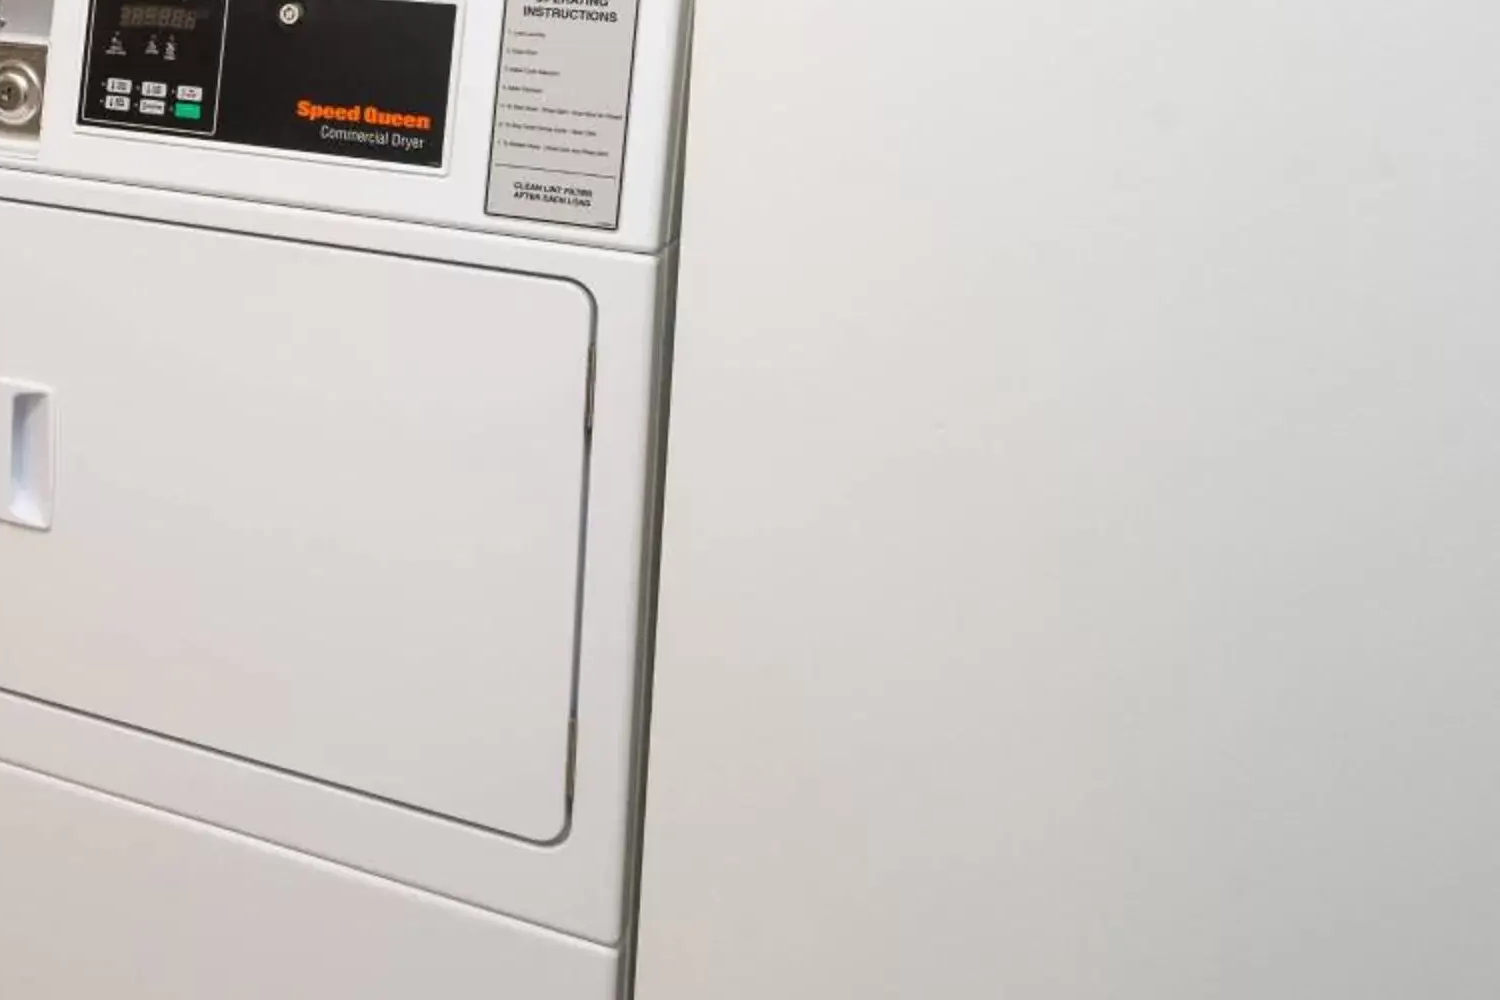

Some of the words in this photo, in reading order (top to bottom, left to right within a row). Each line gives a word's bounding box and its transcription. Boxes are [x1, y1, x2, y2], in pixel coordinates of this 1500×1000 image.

[523, 5, 618, 23] INSTRUCTIONS
[297, 100, 361, 121] Speed
[363, 106, 432, 130] Queen
[320, 125, 389, 145] Commercial
[391, 133, 425, 151] Dryer
